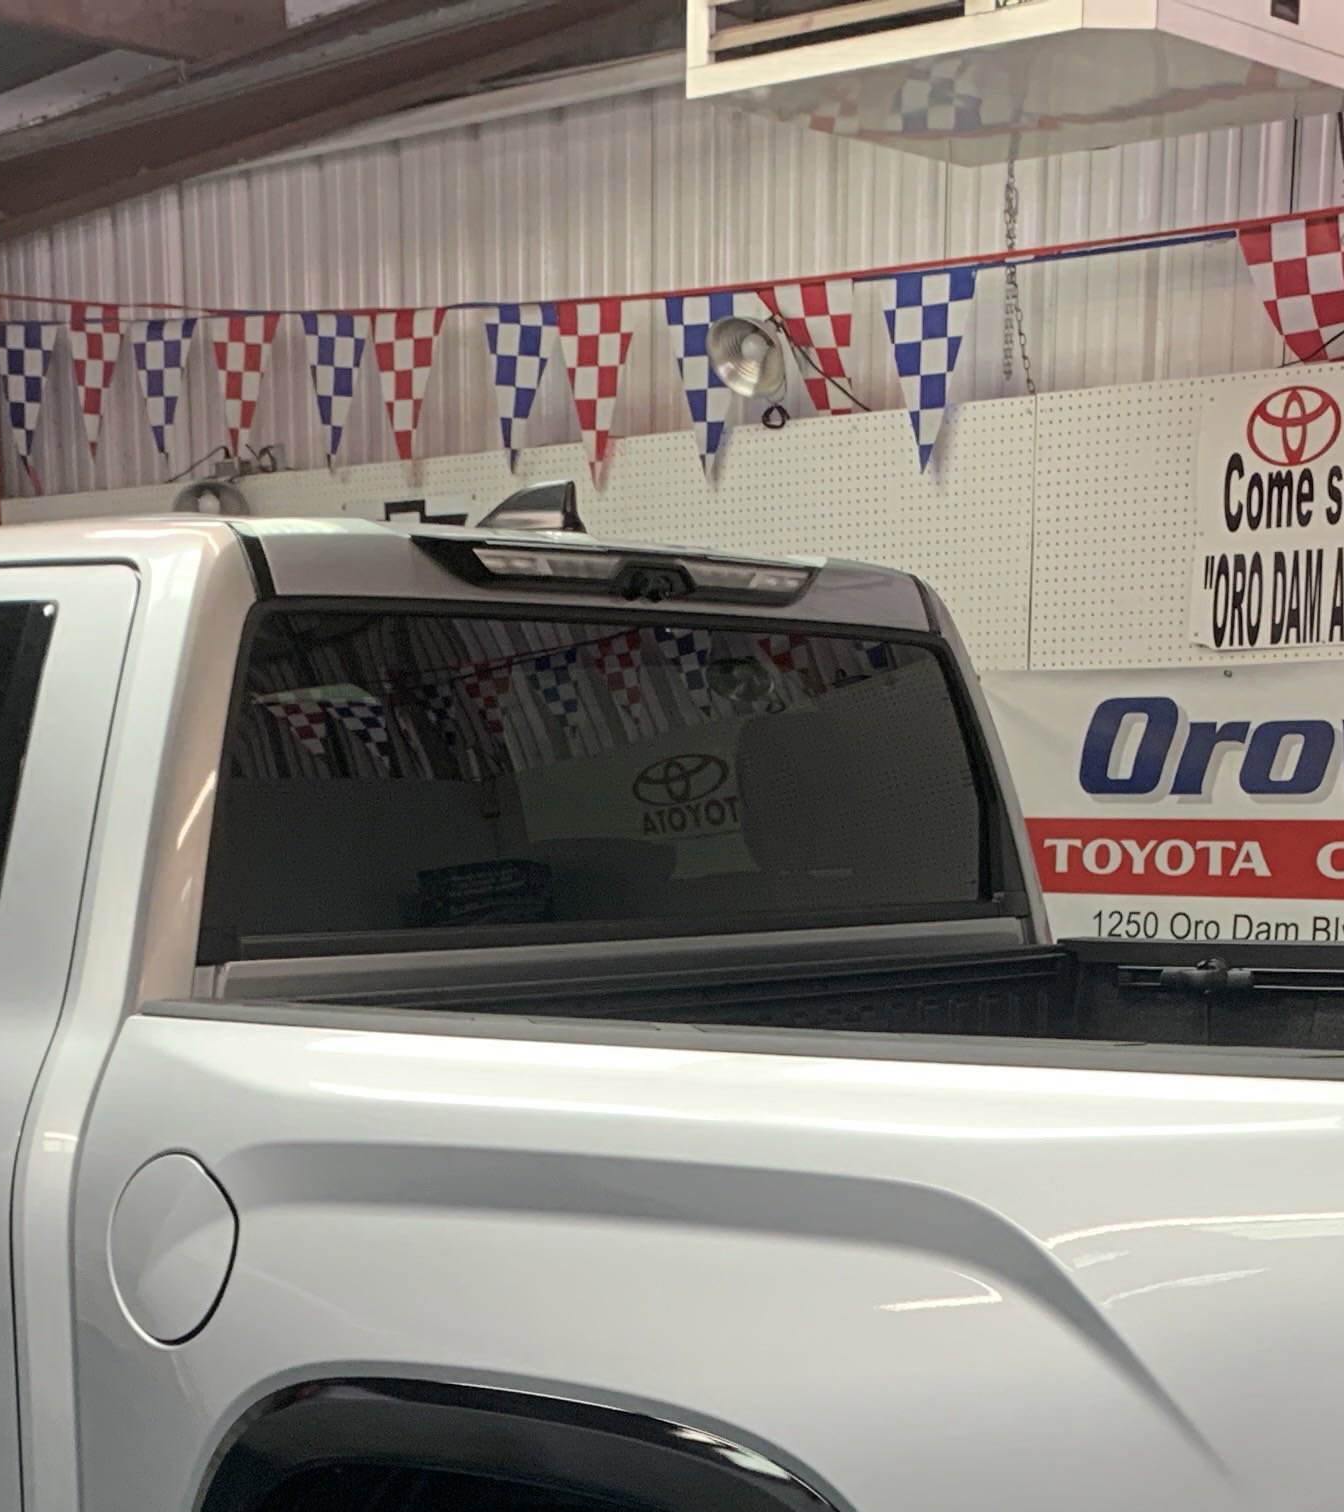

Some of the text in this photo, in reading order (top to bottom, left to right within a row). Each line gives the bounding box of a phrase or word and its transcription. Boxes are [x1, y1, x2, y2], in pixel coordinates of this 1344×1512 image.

[1224, 452, 1315, 533] Come
[1204, 551, 1264, 648] "ORO
[1270, 548, 1324, 645] DAM
[1044, 838, 1272, 878] TOYOTA
[1094, 910, 1158, 938] 1250
[1170, 912, 1220, 939] Oro
[1233, 915, 1299, 940] Dam
